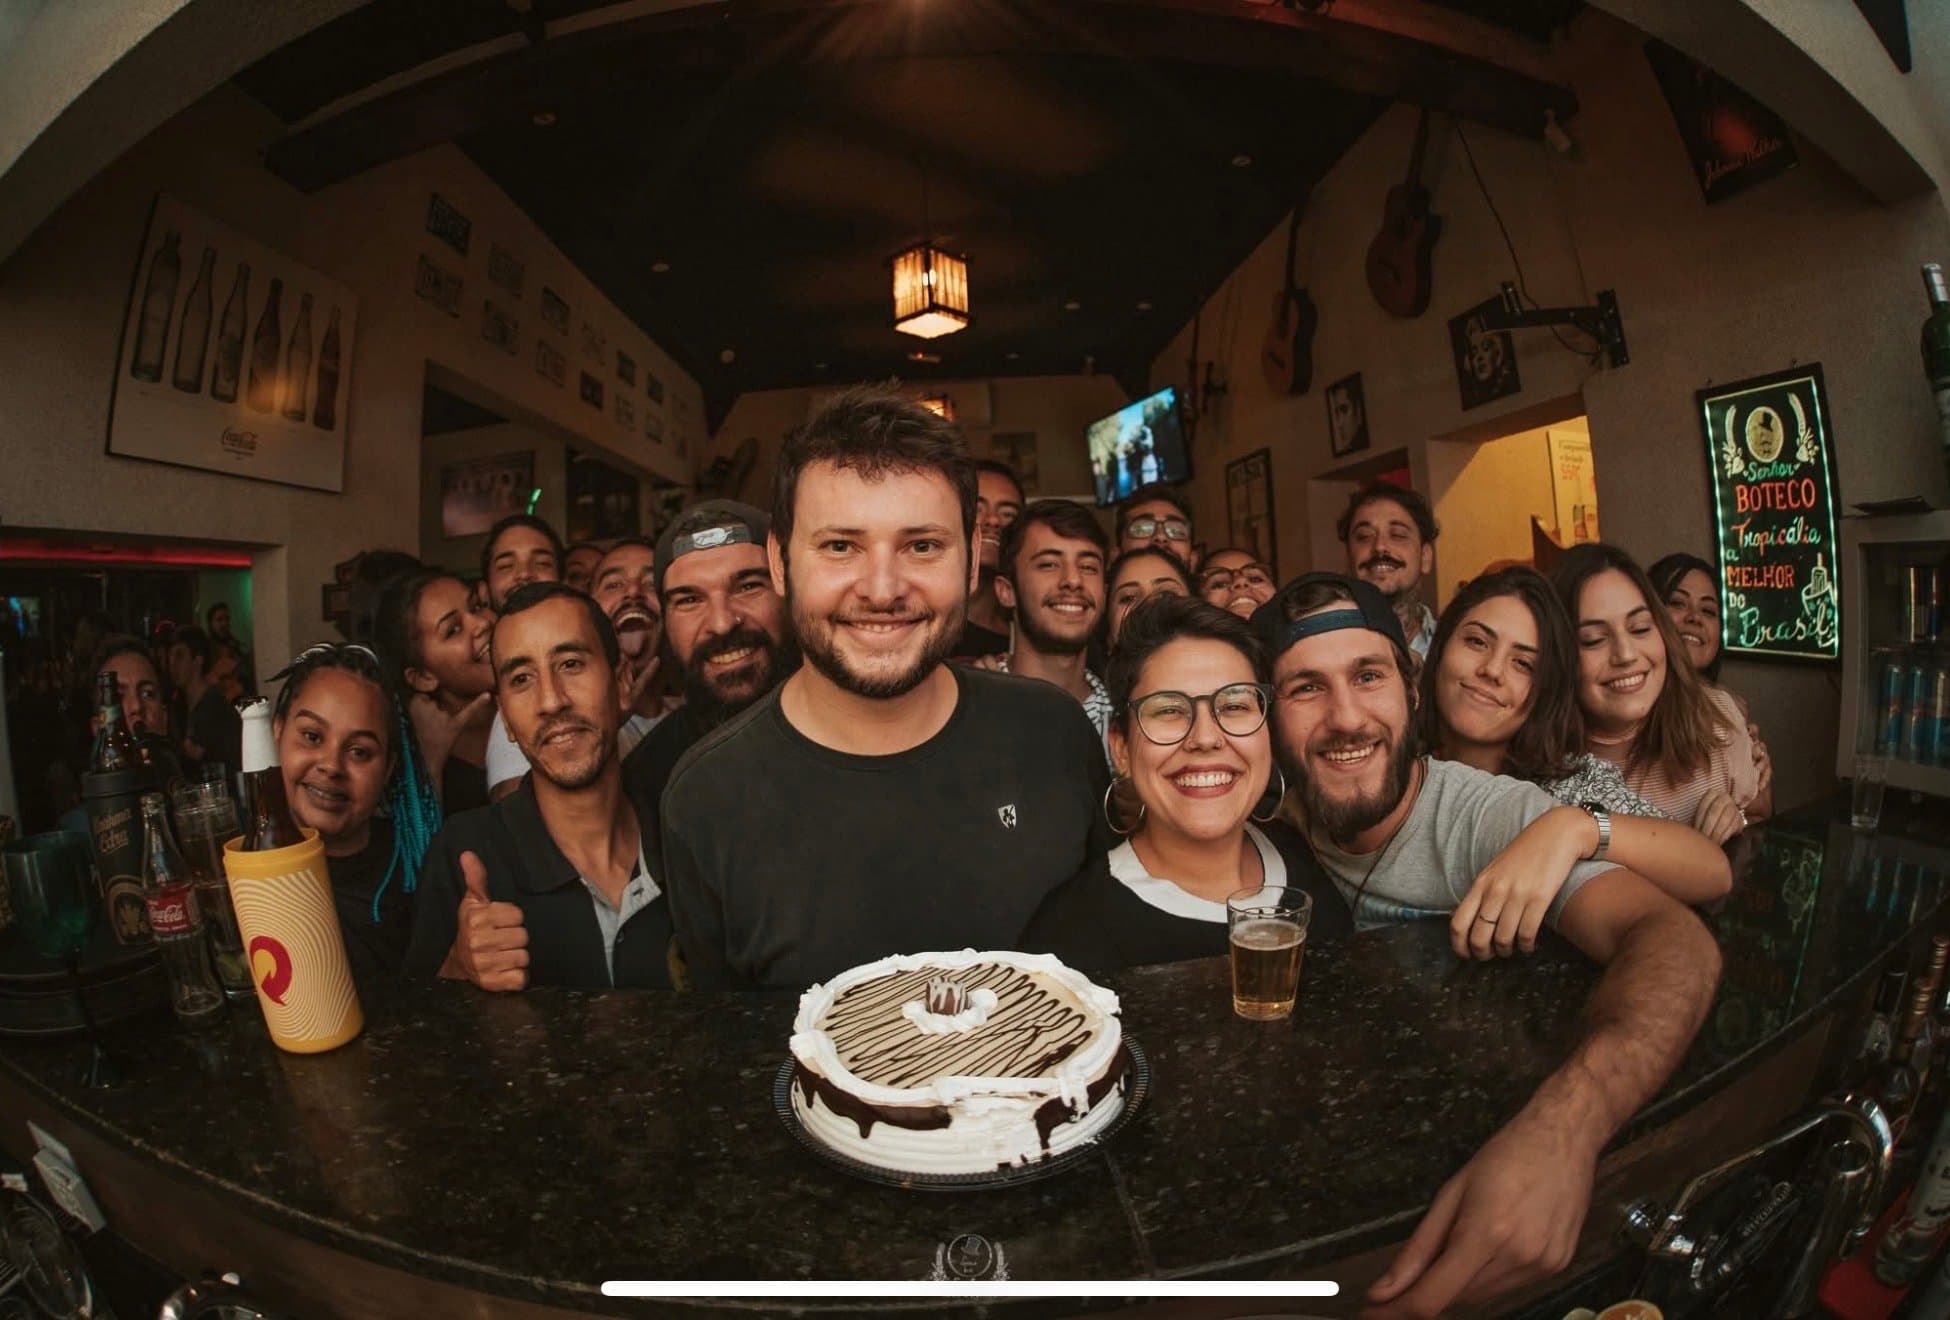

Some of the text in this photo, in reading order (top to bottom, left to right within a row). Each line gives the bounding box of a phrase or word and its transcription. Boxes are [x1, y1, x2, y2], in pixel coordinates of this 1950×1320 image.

[1747, 460, 1794, 481] Senhor
[1735, 478, 1815, 513] BOTECO
[1731, 516, 1821, 556] Tropicália
[1726, 549, 1739, 561] a
[1727, 564, 1794, 588] MELHOR
[1728, 592, 1746, 608] DO
[1739, 602, 1827, 647] Brasil
